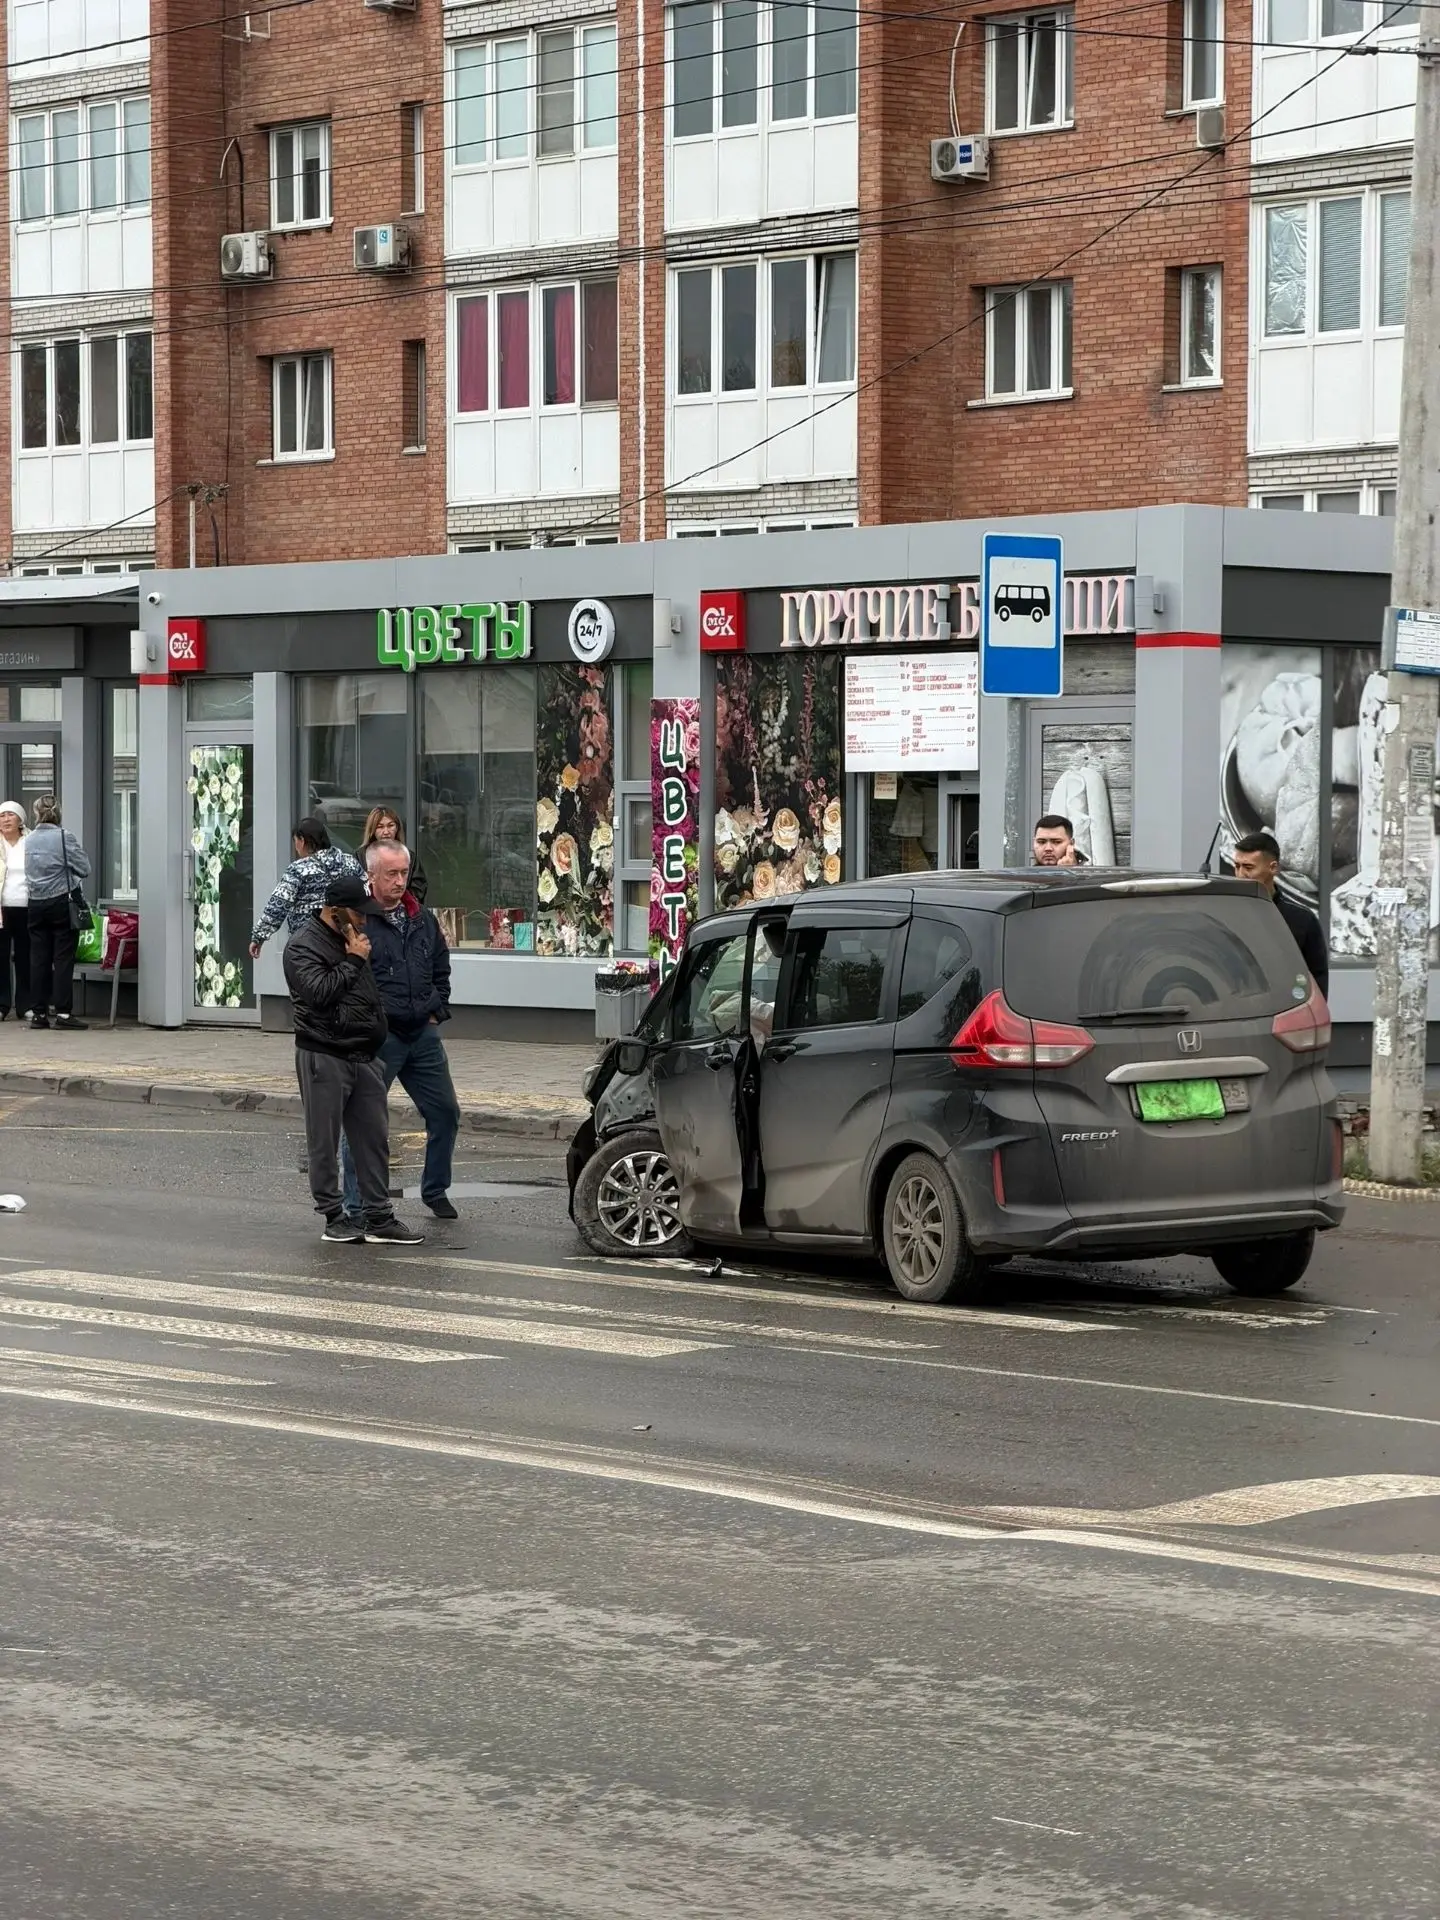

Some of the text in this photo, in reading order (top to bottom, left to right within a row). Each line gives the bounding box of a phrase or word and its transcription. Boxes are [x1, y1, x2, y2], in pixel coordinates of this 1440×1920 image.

[579, 624, 602, 637] 24/7
[780, 575, 1134, 647] ГОРЯЧИЕ БШИ
[377, 600, 532, 673] ЦВЕТЫ
[1061, 1129, 1119, 1142] FREED+
